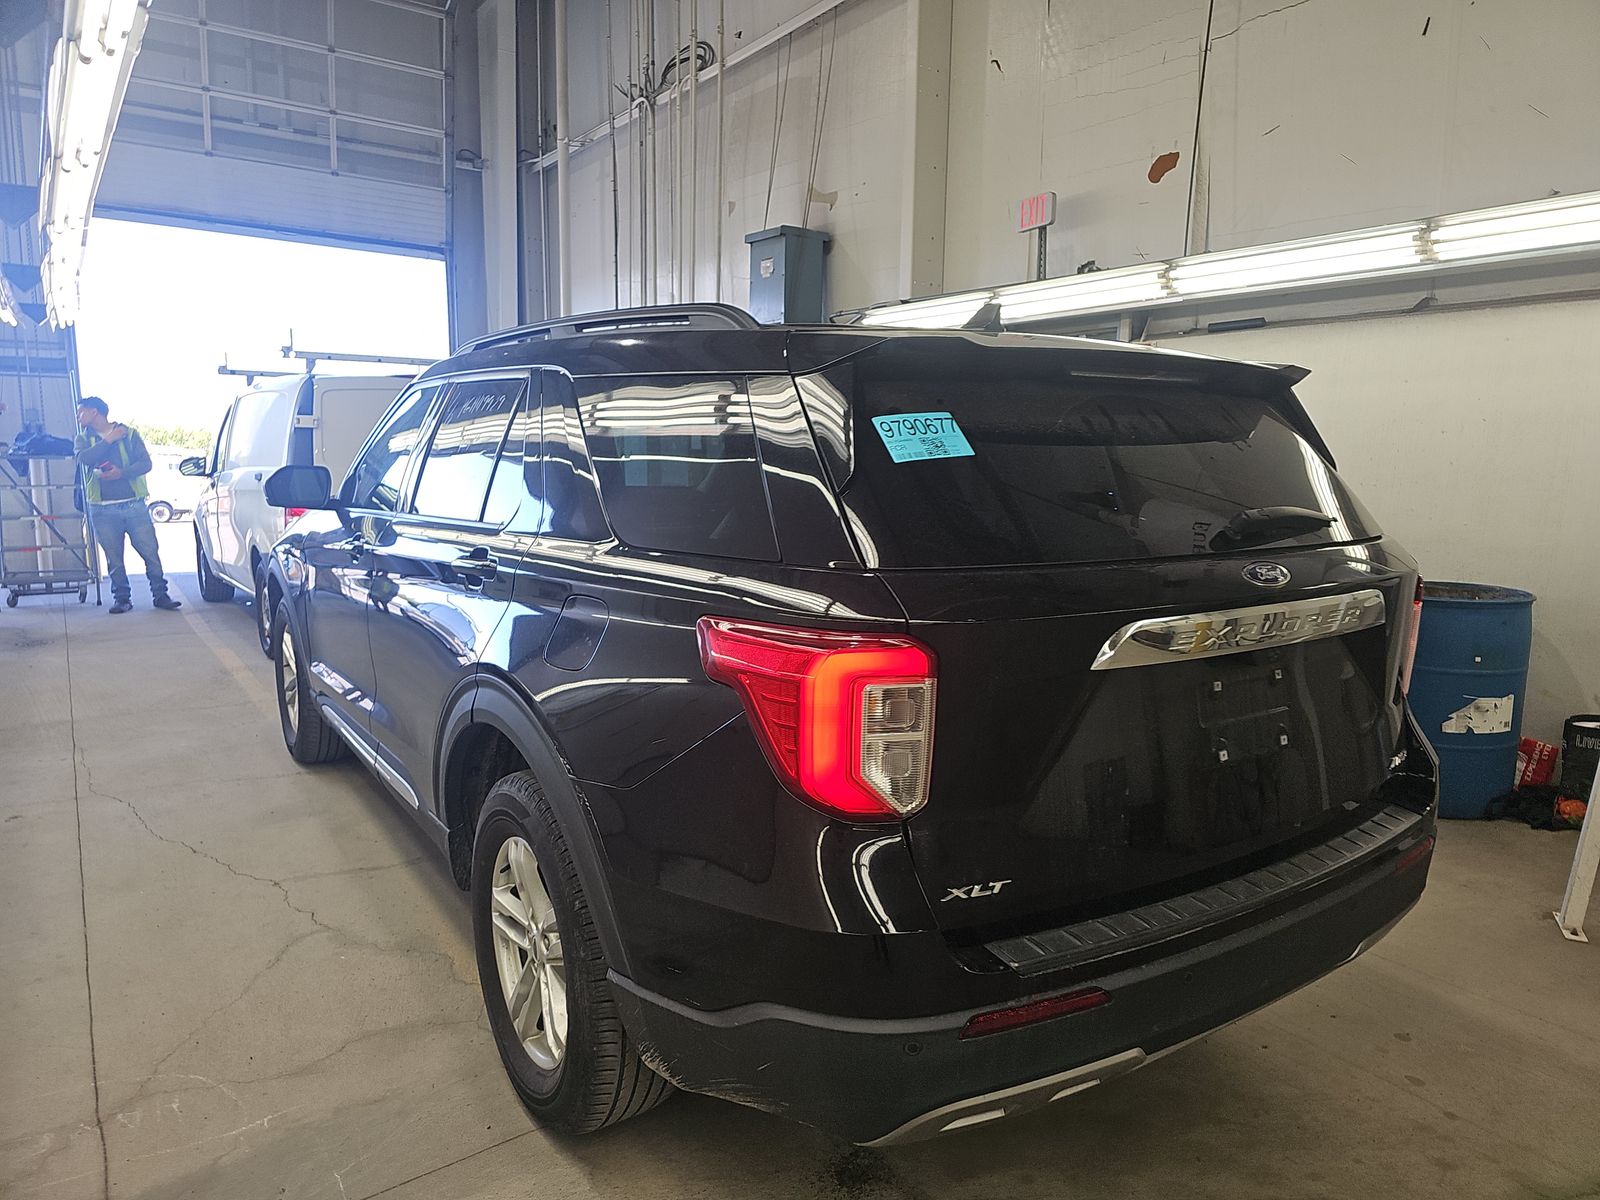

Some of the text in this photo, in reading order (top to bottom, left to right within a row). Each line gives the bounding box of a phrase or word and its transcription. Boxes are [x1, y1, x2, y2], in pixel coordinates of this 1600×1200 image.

[1020, 193, 1047, 229] EXIT
[879, 417, 957, 438] 9790677
[1168, 607, 1361, 652] EXPLORER
[940, 879, 1012, 902] XLT
